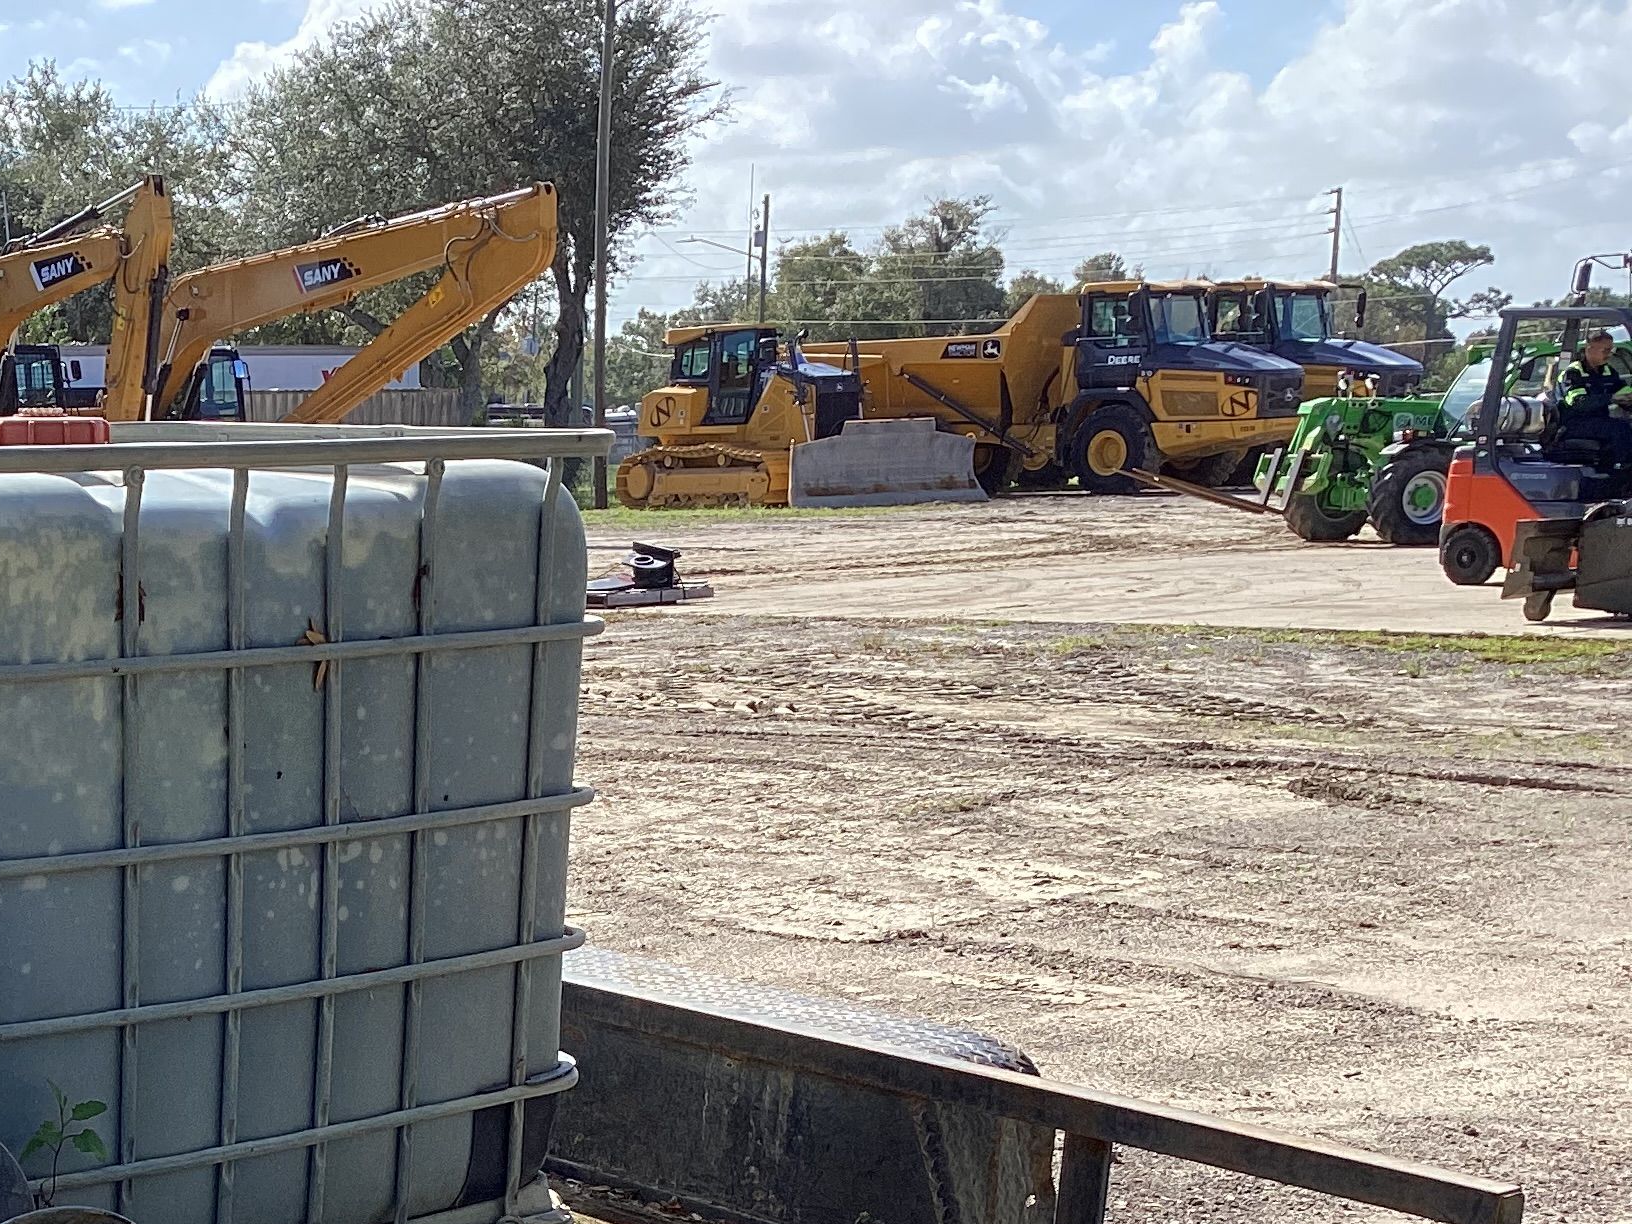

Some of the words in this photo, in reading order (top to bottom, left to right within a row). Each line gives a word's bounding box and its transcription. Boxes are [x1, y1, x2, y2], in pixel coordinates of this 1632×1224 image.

[40, 256, 74, 283] SANY
[303, 262, 341, 287] SANY
[1107, 354, 1141, 365] DEERE
